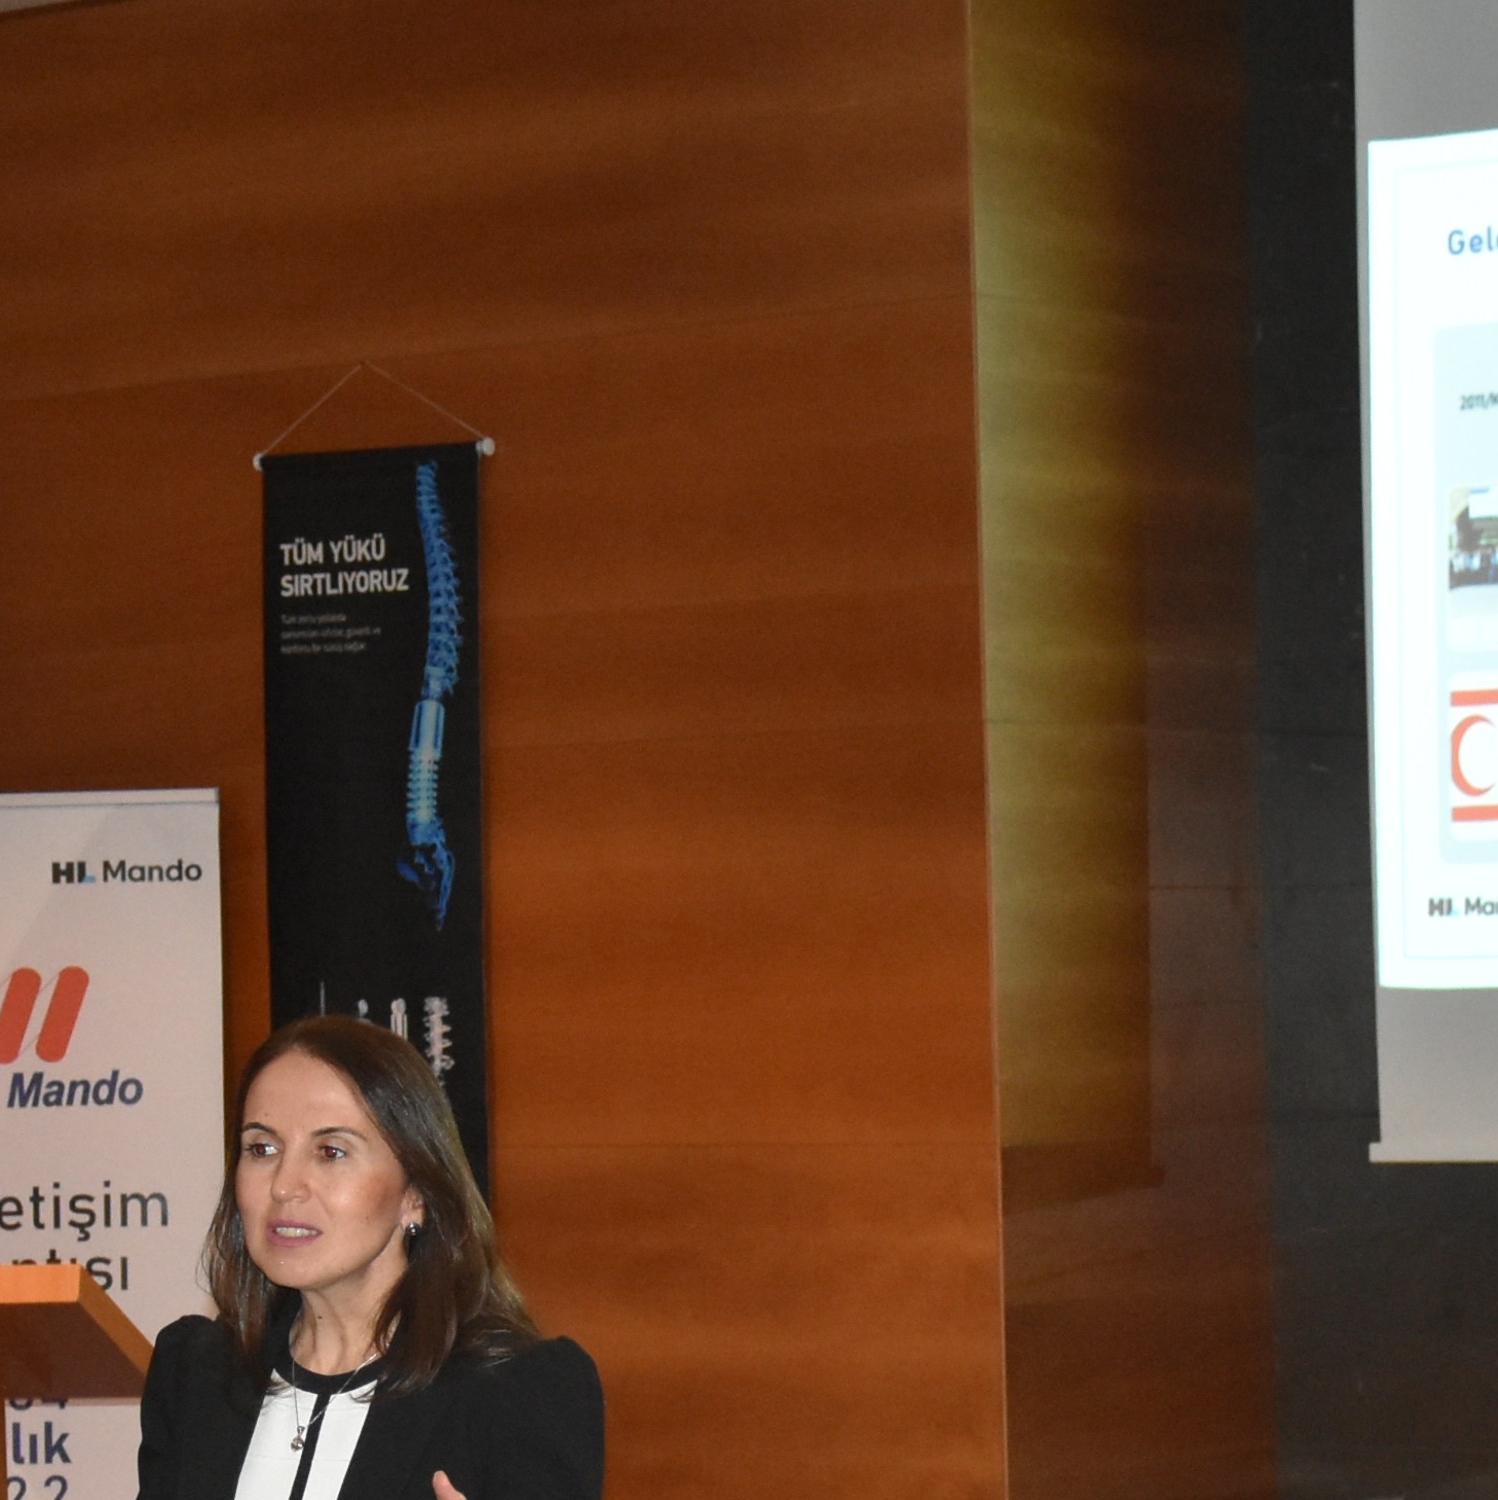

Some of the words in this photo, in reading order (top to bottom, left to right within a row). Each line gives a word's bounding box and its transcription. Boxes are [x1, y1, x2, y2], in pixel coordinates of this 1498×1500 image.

[280, 537, 324, 566] TÜM
[330, 532, 386, 563] YÜKÜ
[280, 568, 410, 597] SIRTLIYORUZ
[102, 859, 203, 883] Mando
[7, 1070, 144, 1108] Mando
[12, 1421, 72, 1465] lık
